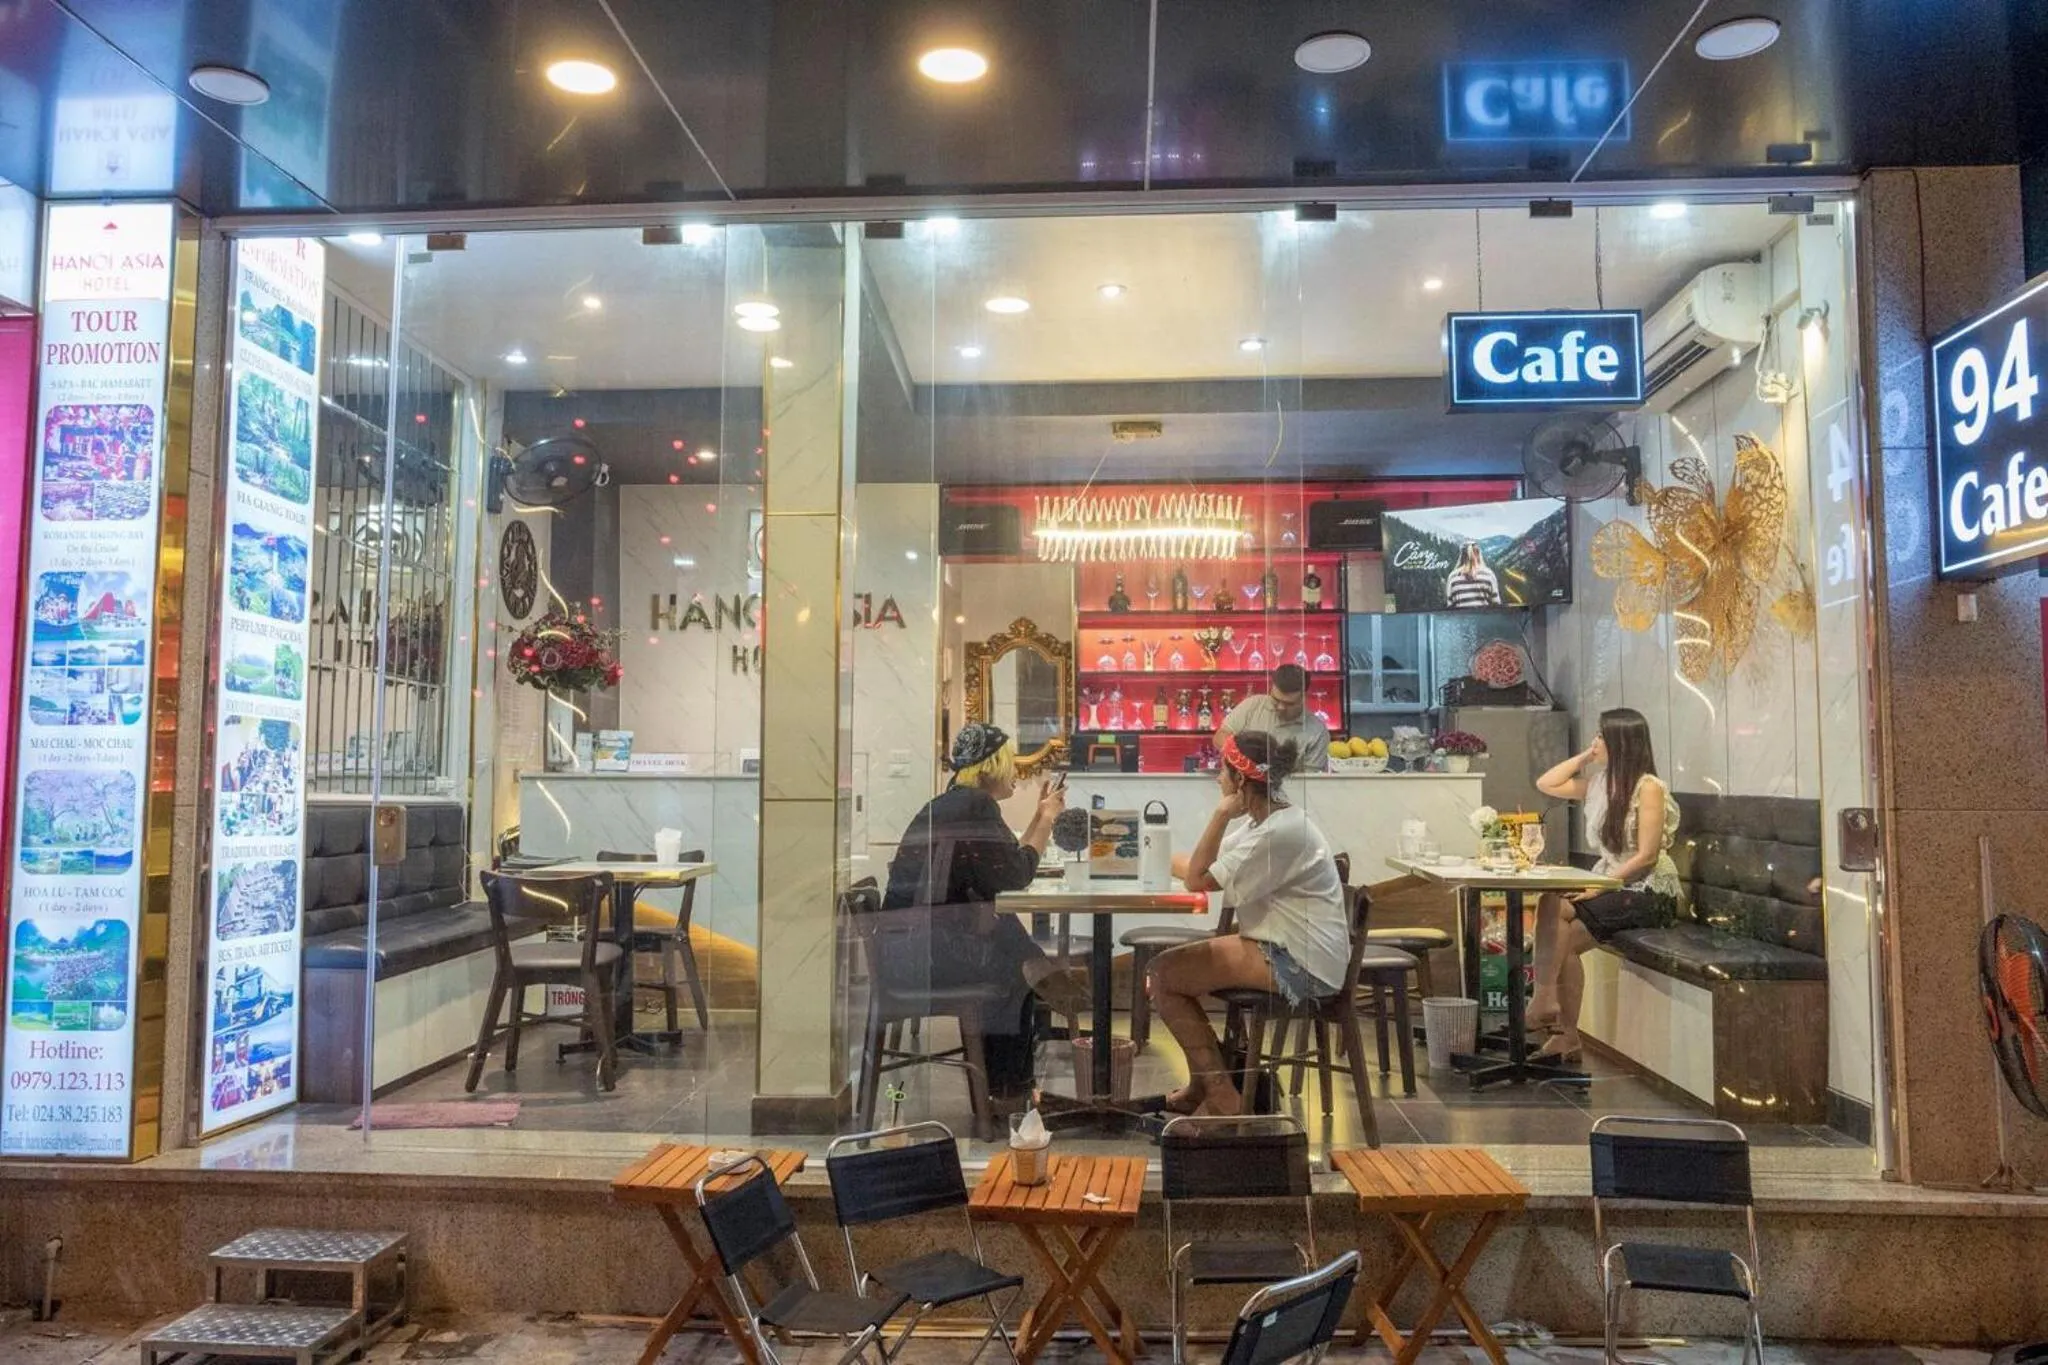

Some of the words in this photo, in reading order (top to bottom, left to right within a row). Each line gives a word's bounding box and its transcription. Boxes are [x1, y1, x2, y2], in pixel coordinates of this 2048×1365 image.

[52, 255, 113, 271] HANOI
[122, 253, 164, 269] ASIA
[83, 277, 131, 292] HOTEL
[71, 310, 138, 332] TOUR
[47, 342, 160, 365] PROMOTION
[1473, 331, 1619, 383] Cafe
[1951, 318, 2038, 445] 94
[1951, 452, 2048, 542] Cafe
[23, 887, 48, 898] HOA
[30, 1040, 104, 1059] Hotline:
[11, 1071, 125, 1090] 0979.123.113
[6, 1104, 29, 1121] Tel:
[32, 1104, 122, 1122] 024.38.245.183
